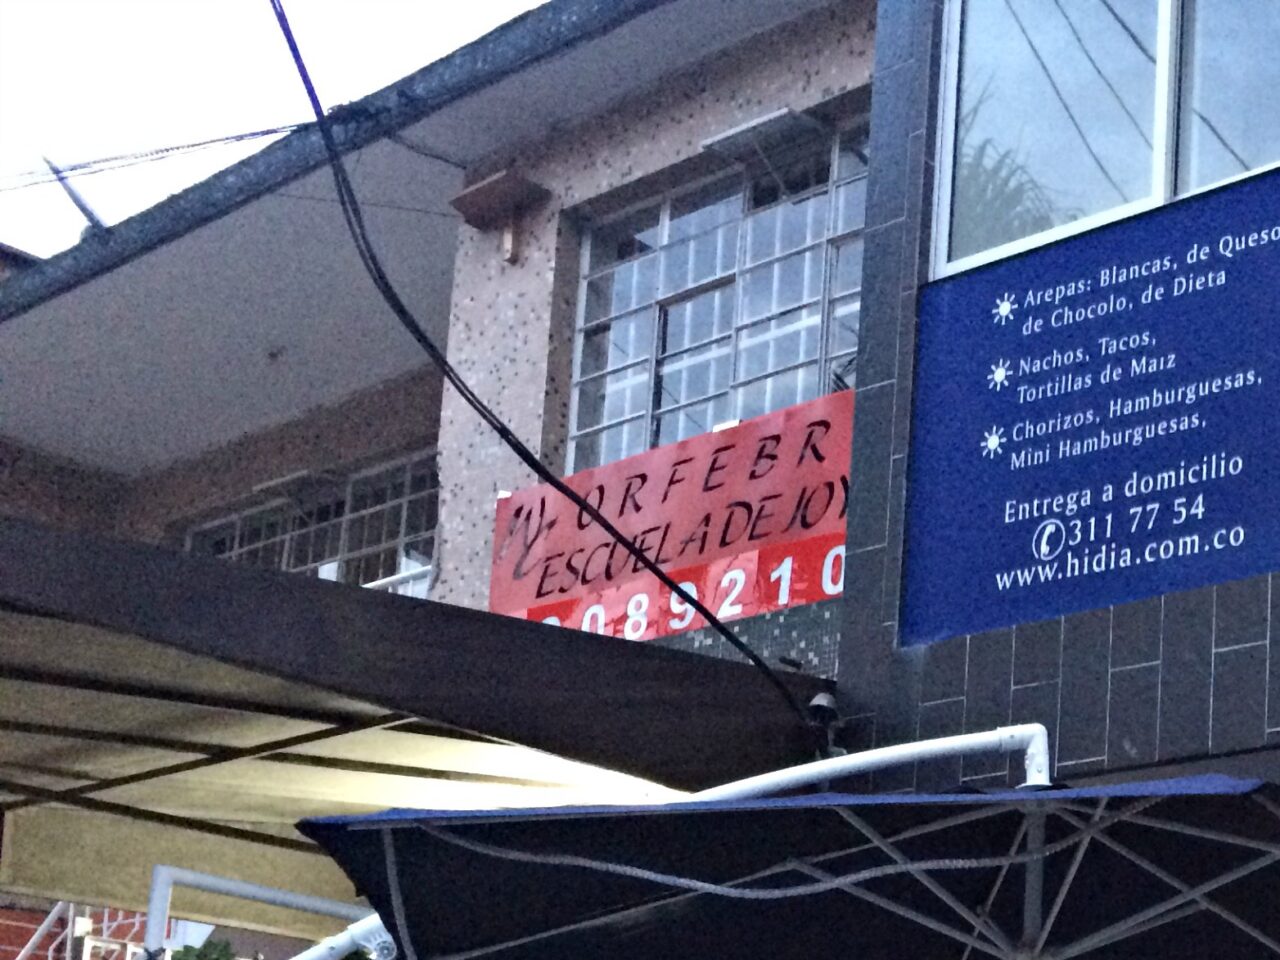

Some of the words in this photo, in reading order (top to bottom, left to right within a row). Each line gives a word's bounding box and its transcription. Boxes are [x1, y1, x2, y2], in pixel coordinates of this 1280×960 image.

[1022, 315, 1044, 336] de
[1050, 293, 1133, 328] Chocolo,
[1141, 283, 1165, 305] de
[1173, 270, 1226, 297] Dieta
[1023, 279, 1092, 309] Arepas:
[1099, 255, 1178, 288] Blancas,
[1186, 242, 1210, 265] de
[1017, 373, 1092, 404] Tortillas
[1100, 363, 1123, 385] de
[1018, 348, 1090, 377] Nachos,
[1098, 331, 1156, 356] Tacos,
[1012, 409, 1100, 442] Chorizos,
[1109, 369, 1262, 419] Hamburguesas,
[1010, 443, 1050, 471] Mini
[1058, 412, 1206, 459] Hamburguesas,
[1004, 488, 1091, 524] Entrega
[1101, 484, 1114, 503] a
[1124, 453, 1243, 498] domicilio
[1068, 512, 1113, 546] 311
[1129, 502, 1160, 533] 77
[1172, 493, 1206, 525] 54
[995, 525, 1245, 591] www.hidia.com.co
[541, 545, 846, 642] 089210
